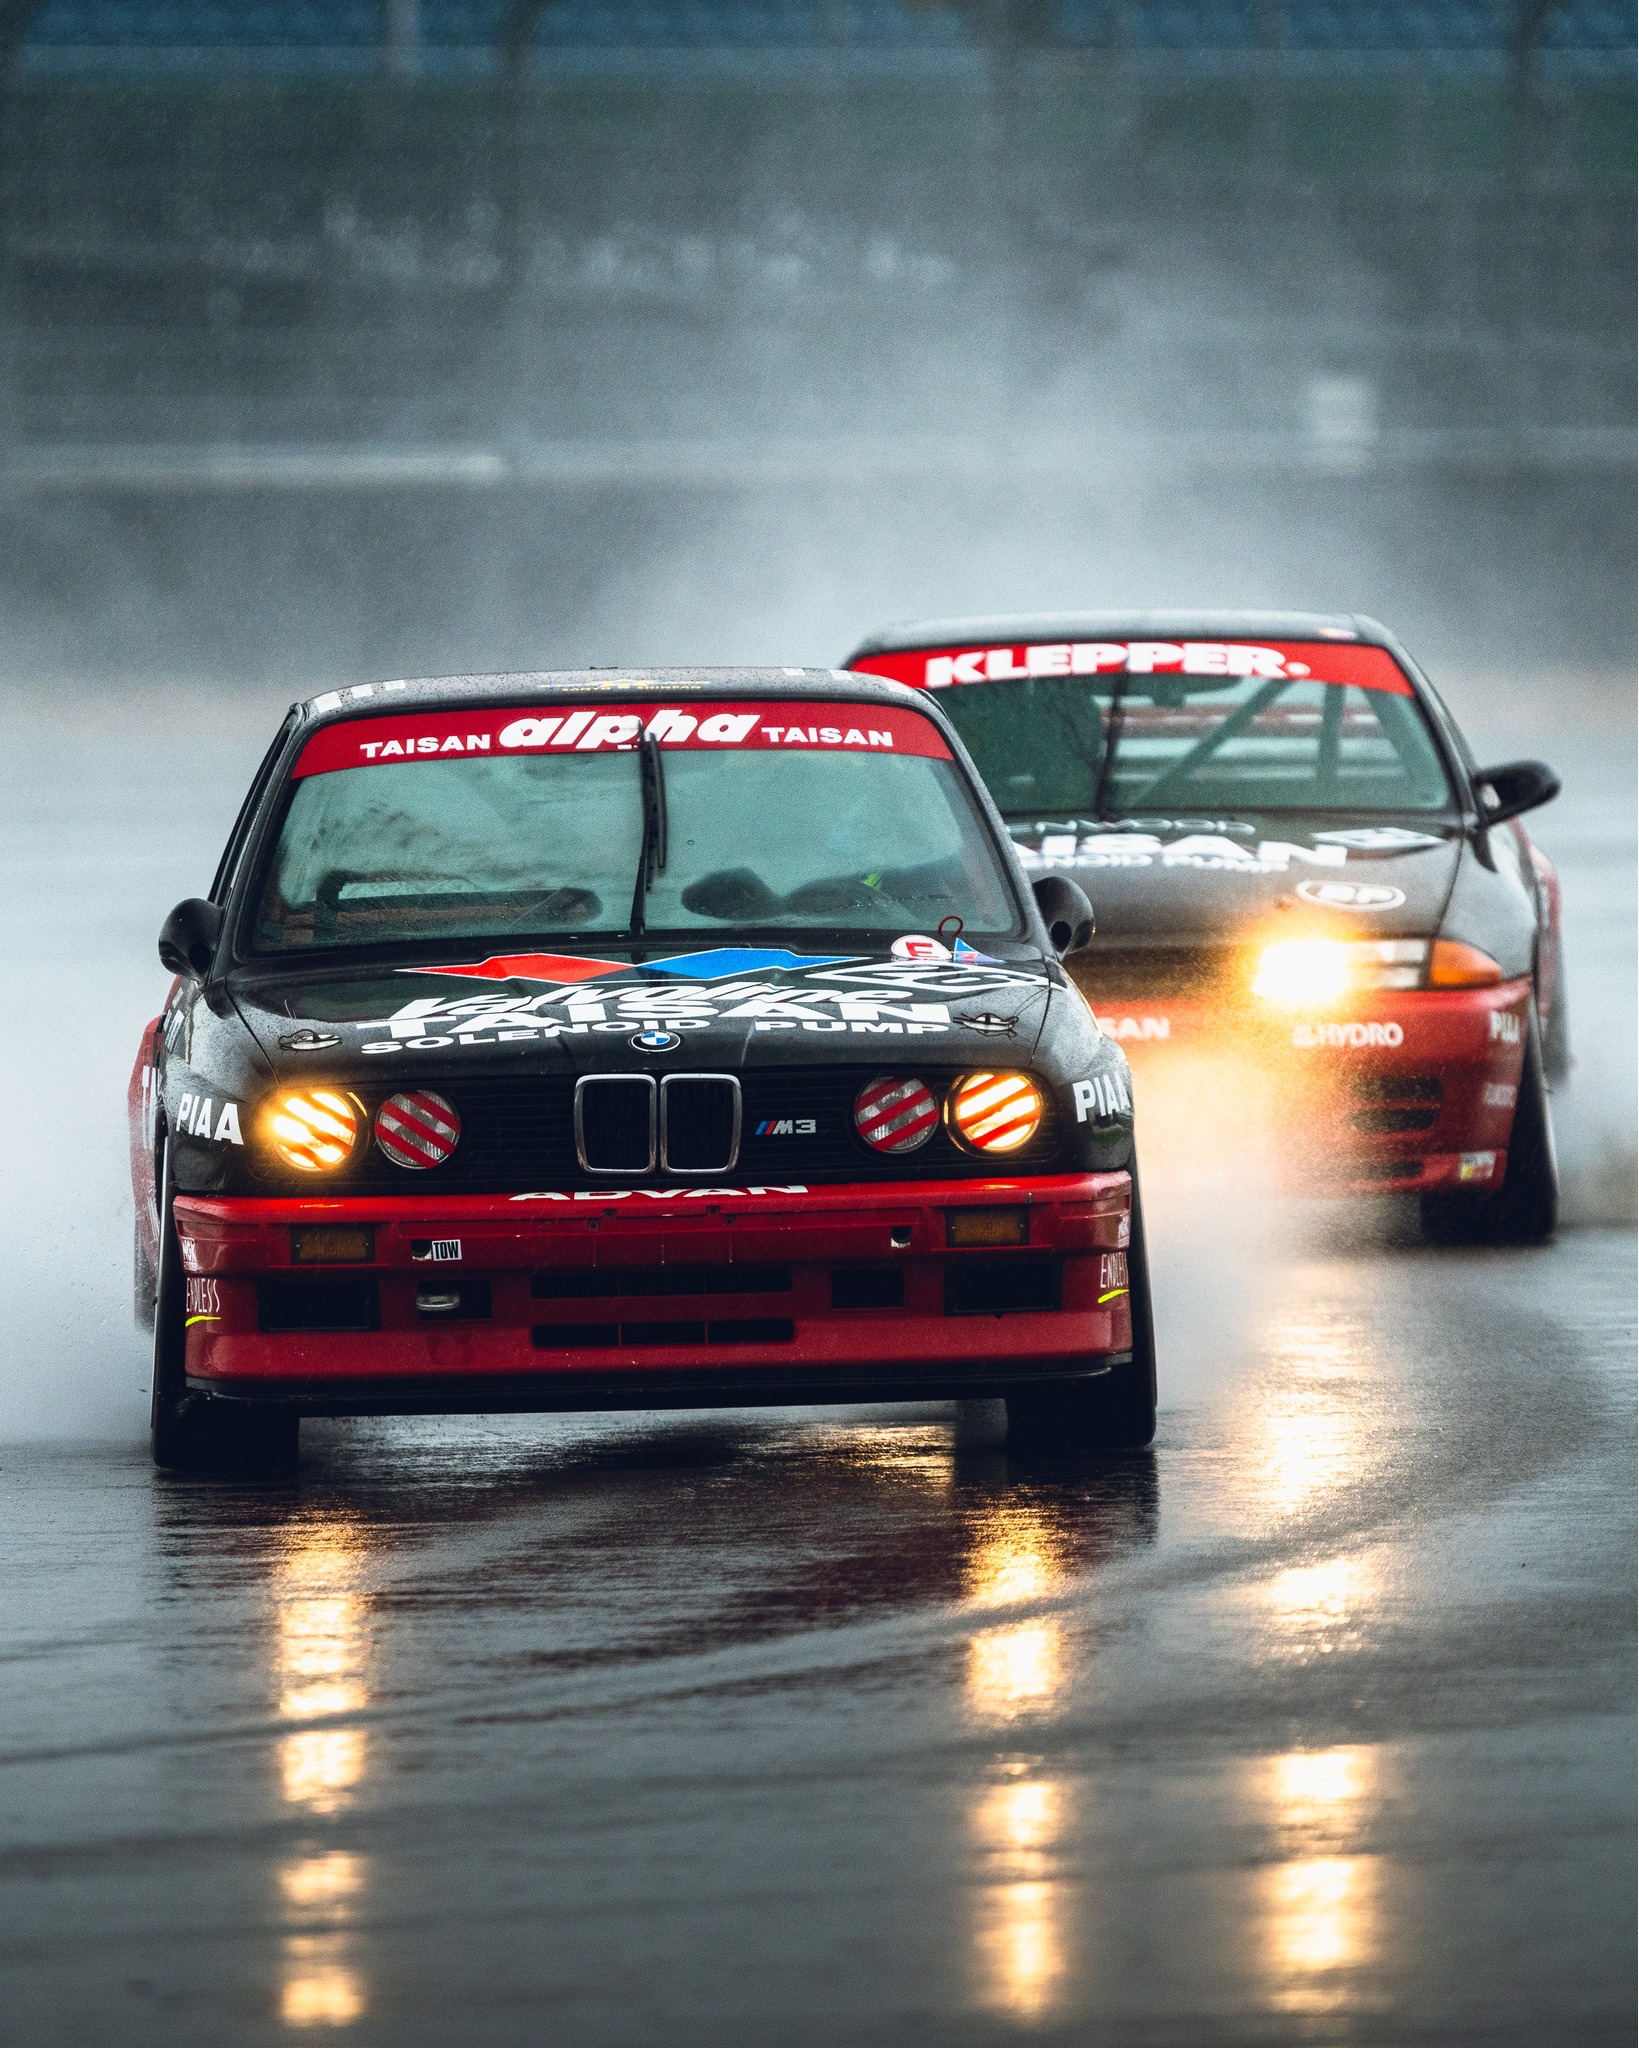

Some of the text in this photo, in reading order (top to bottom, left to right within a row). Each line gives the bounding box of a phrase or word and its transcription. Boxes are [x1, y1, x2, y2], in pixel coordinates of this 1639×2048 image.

[925, 642, 1288, 689] KLEPPER
[359, 709, 894, 758] TAISAN alpha TAISAN
[905, 941, 937, 959] E
[356, 999, 951, 1039] TAISAN
[387, 981, 913, 1021] Valvoline
[361, 1020, 711, 1054] SOLENOID
[755, 1021, 950, 1034] PUMP
[1319, 1021, 1404, 1047] HYDRO
[1072, 1071, 1131, 1123] PIAA
[176, 1092, 245, 1146] PIAA
[772, 1119, 817, 1135] M3
[508, 1185, 809, 1201] ADVAN
[433, 1241, 459, 1260] TOW
